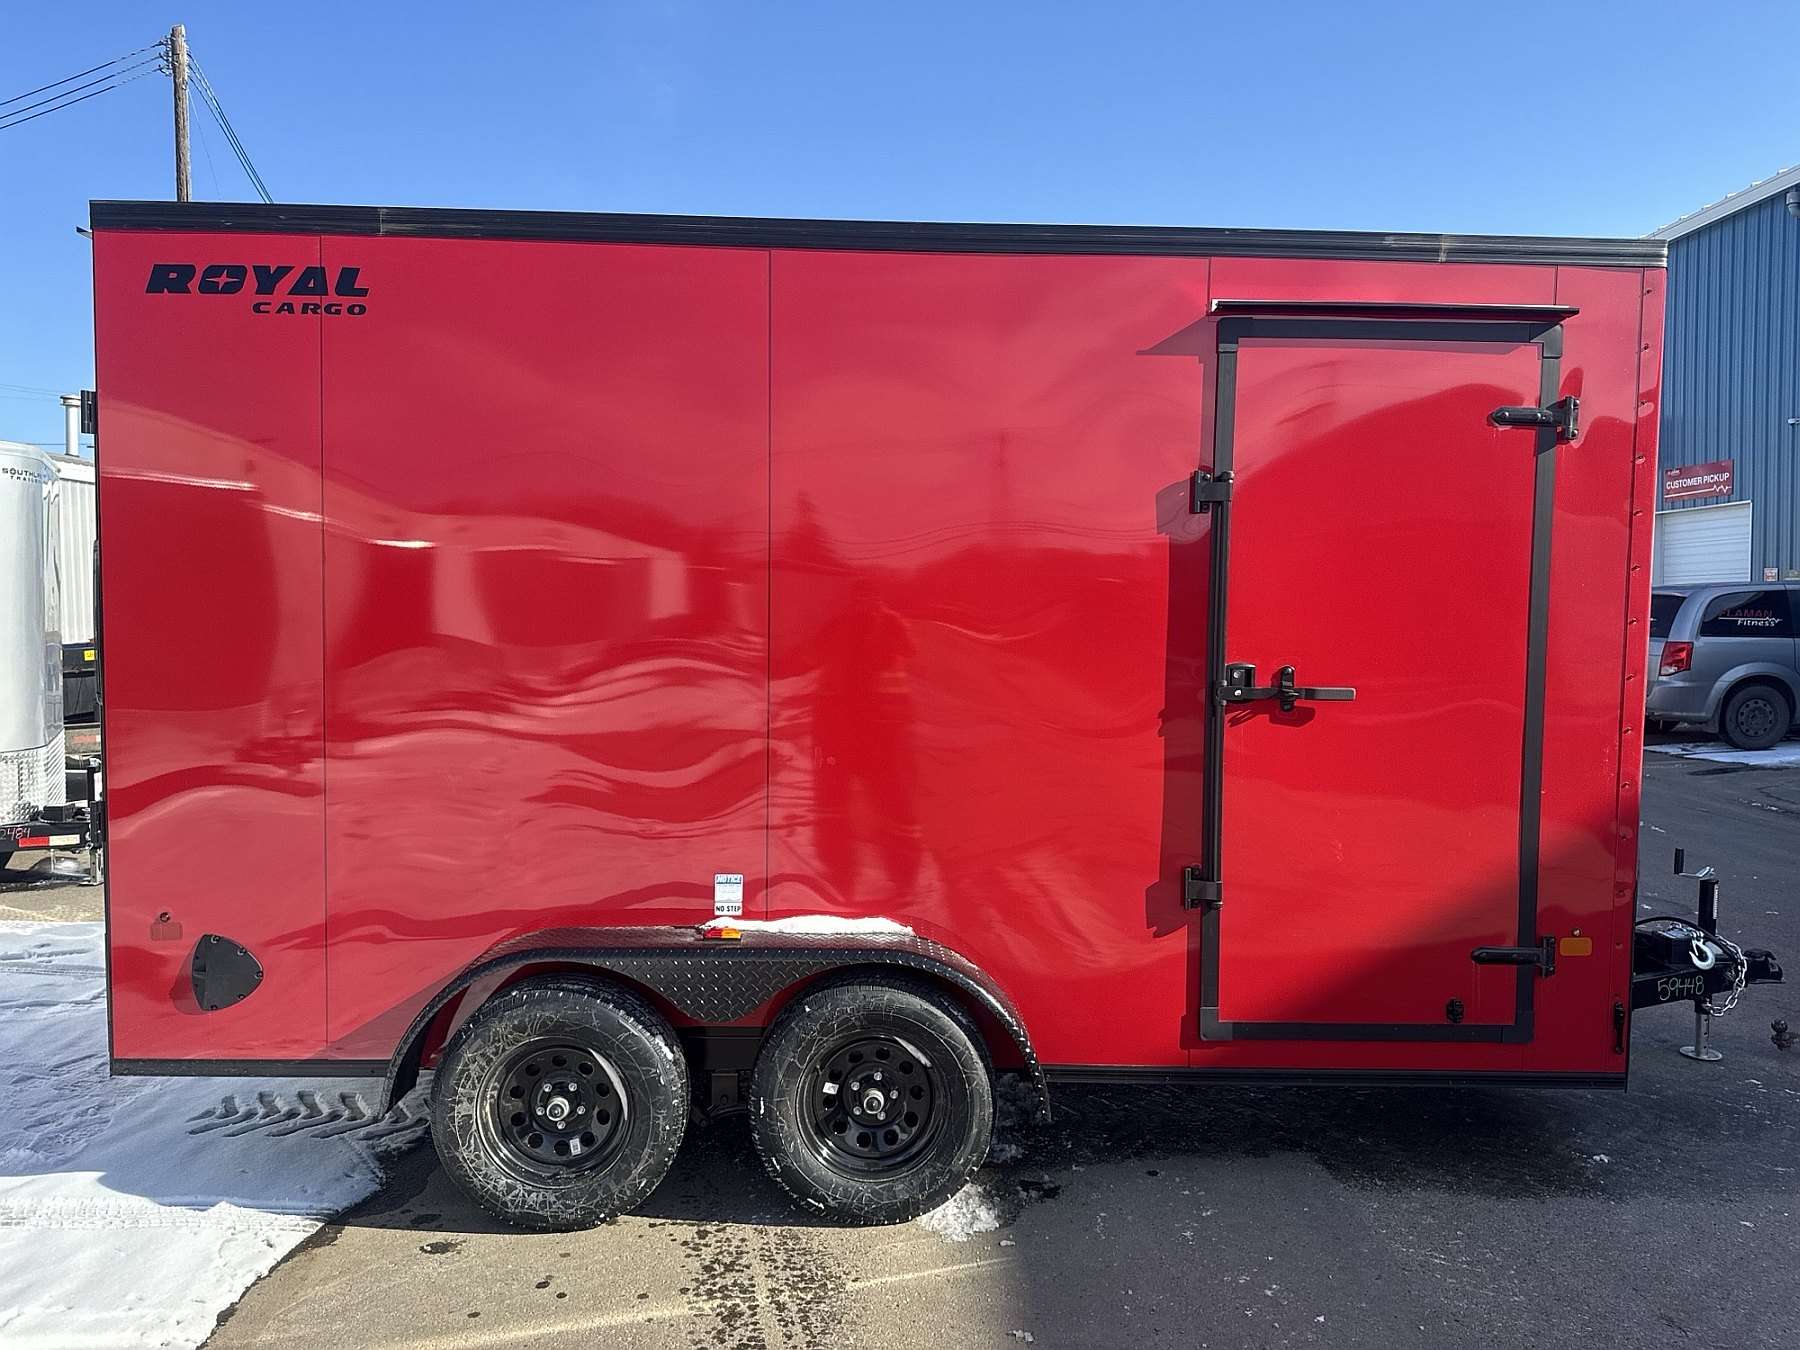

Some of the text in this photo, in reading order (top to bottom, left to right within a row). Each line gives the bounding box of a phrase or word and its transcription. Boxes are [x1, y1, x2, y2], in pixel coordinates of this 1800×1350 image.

[145, 264, 370, 297] ROYAL
[252, 301, 367, 316] CARGO
[1666, 476, 1703, 490] CUSTOMER
[1737, 619, 1775, 627] Fitness
[1657, 975, 1705, 1001] 59448
